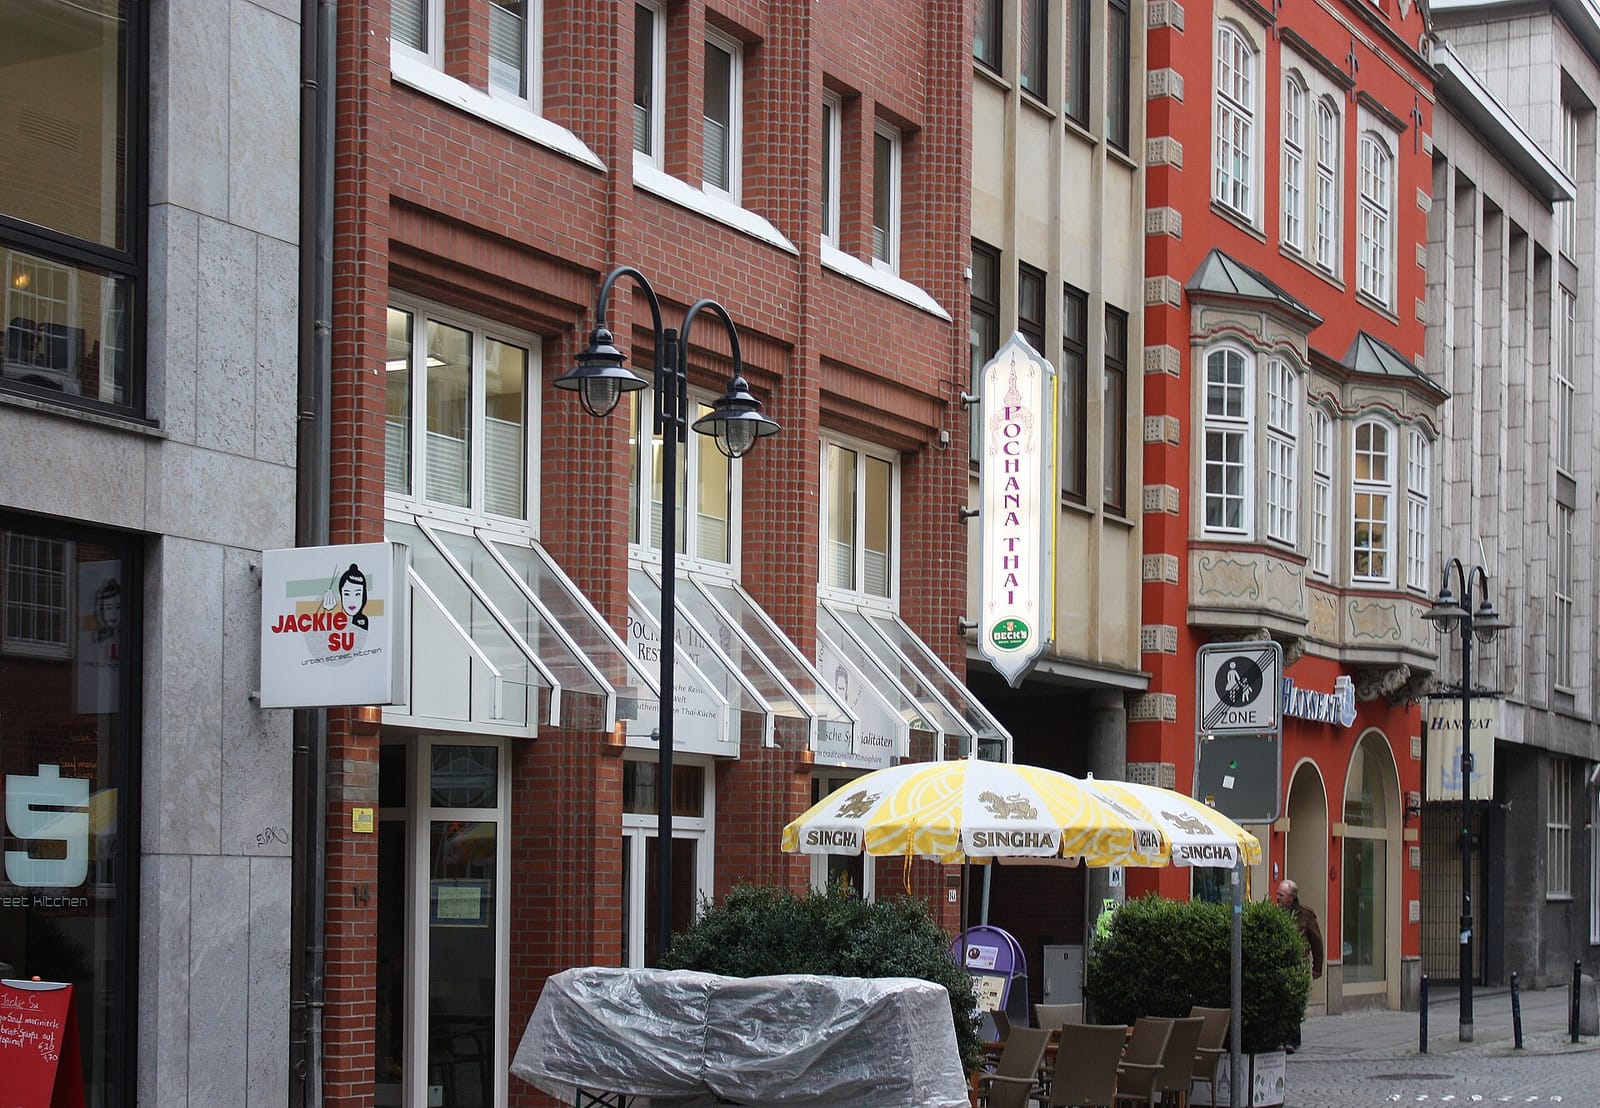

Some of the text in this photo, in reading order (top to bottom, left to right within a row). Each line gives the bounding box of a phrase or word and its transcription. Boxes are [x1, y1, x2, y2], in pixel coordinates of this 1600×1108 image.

[1003, 406, 1021, 604] POCHANA THAI
[328, 633, 354, 651] SU
[301, 647, 382, 666] urban street kitchen
[1281, 677, 1339, 723] HANSEAT
[1220, 710, 1256, 724] ZONE
[1430, 717, 1493, 730] HANEAT
[806, 830, 857, 848] SINGHA
[972, 831, 1054, 848] SINGHA
[1181, 846, 1232, 860] SINGHA
[33, 895, 88, 907] kitchen
[353, 883, 370, 907] 14
